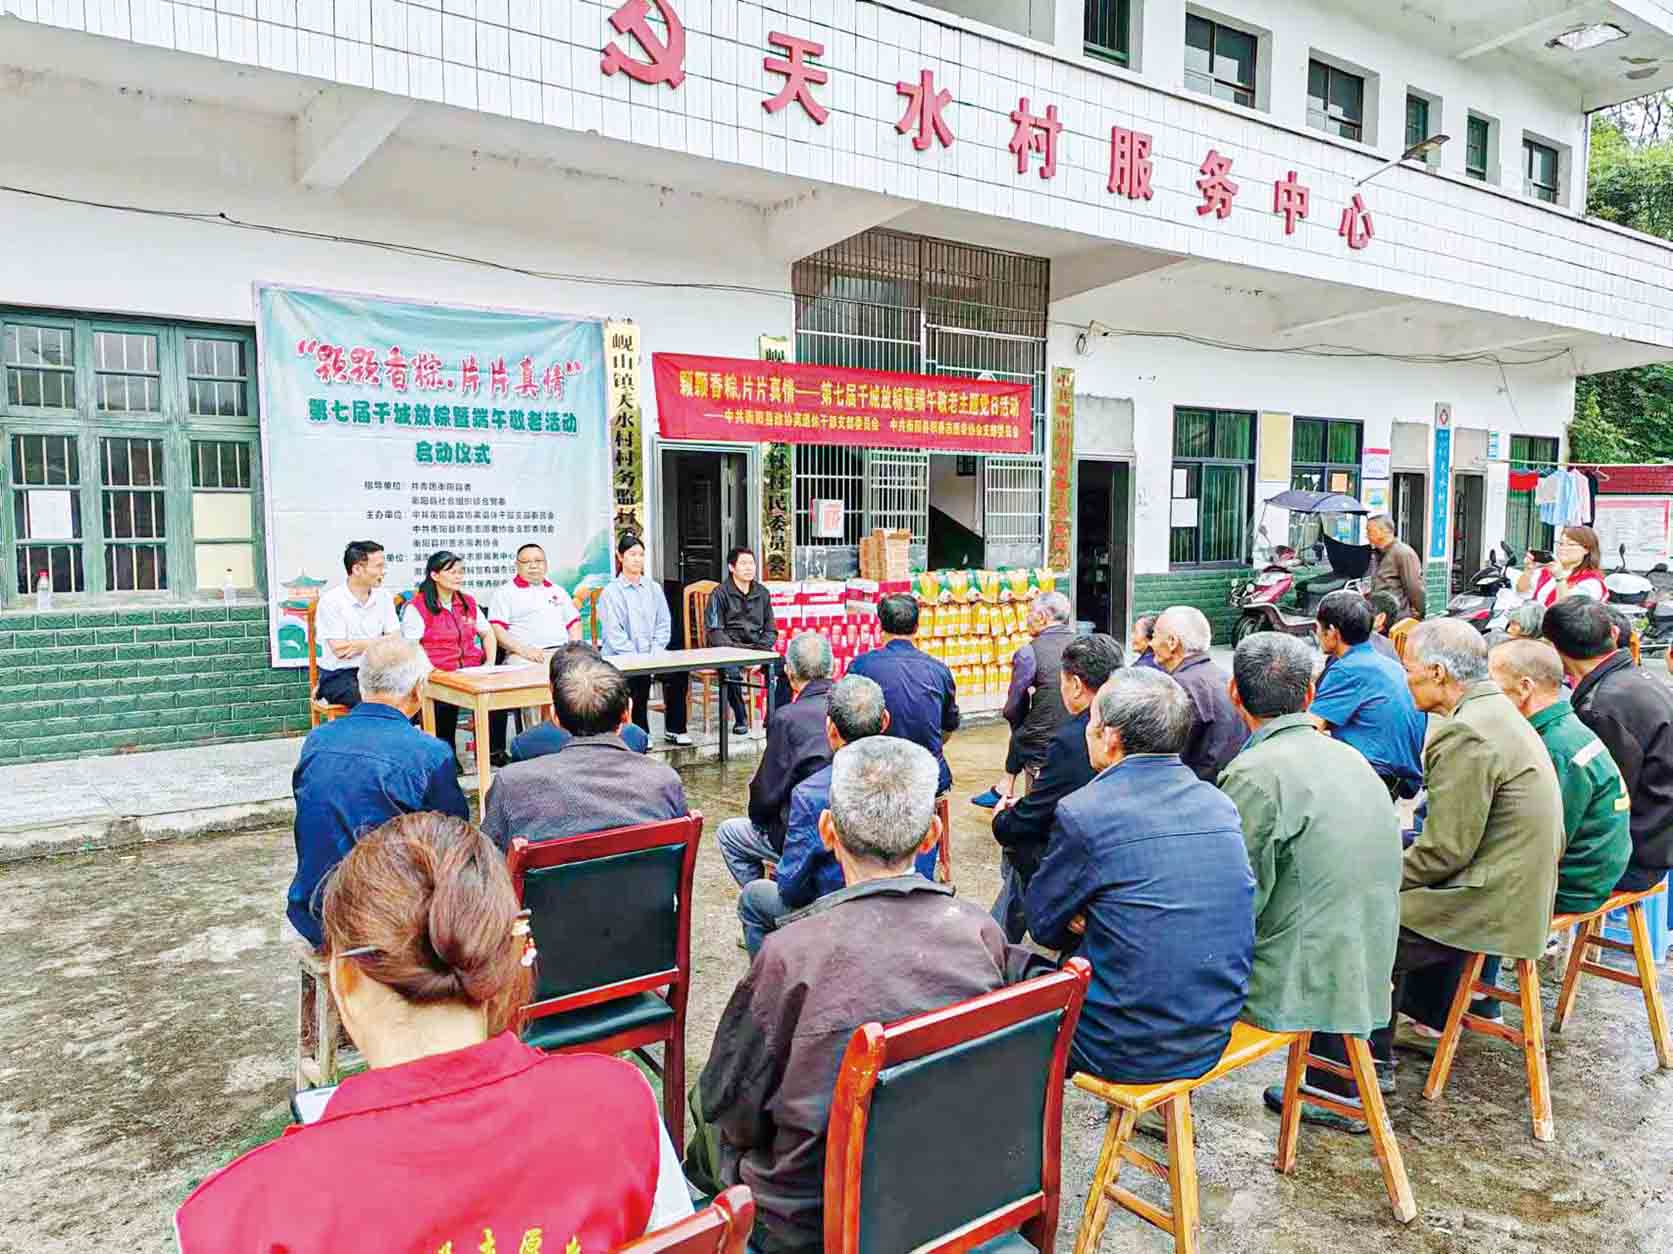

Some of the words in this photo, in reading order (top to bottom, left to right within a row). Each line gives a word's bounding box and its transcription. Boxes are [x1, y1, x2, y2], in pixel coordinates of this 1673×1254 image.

[762, 31, 1375, 249] 天水村服务中心
[415, 440, 492, 465] 启动仪式
